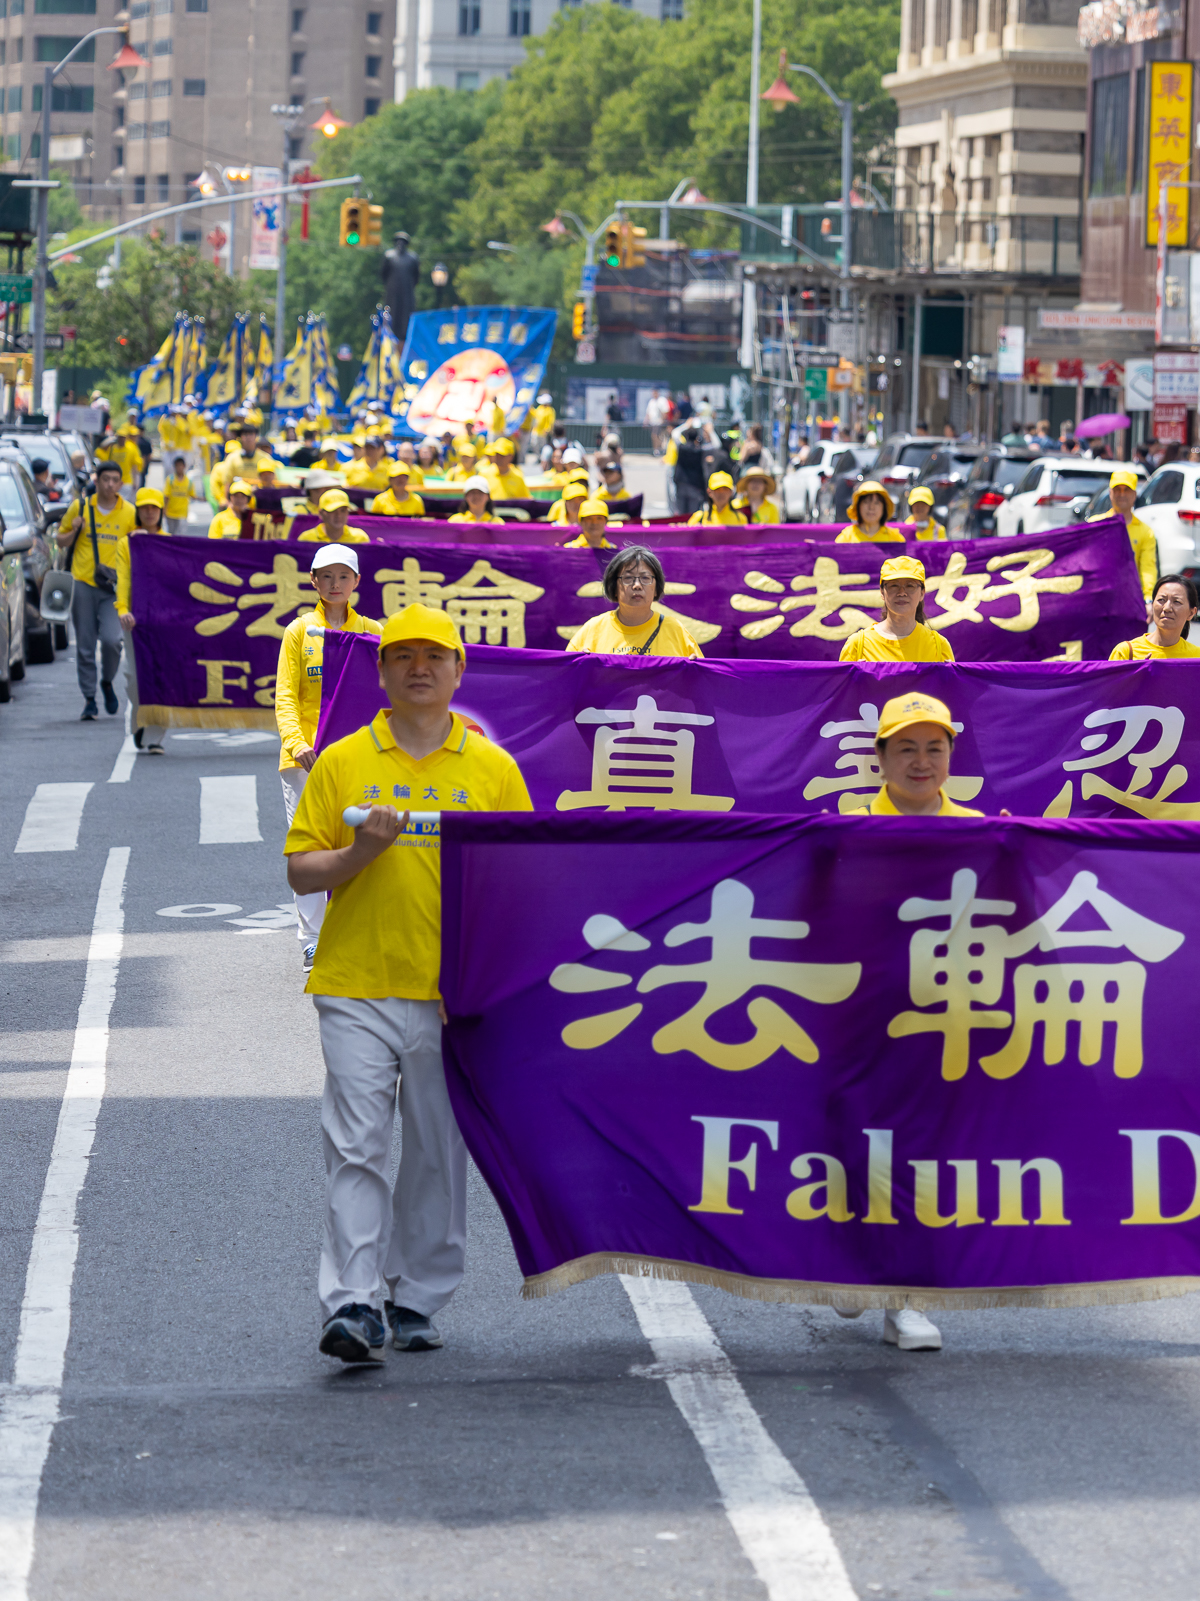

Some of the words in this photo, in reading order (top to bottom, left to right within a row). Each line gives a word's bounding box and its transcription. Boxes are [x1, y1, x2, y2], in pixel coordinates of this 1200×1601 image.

[189, 549, 1084, 648] 法輪大法好
[309, 668, 322, 676] FAL
[363, 784, 469, 804] 法輪大法
[422, 823, 441, 833] DA
[391, 837, 441, 848] alundafa.o
[689, 1115, 1071, 1228] Falun
